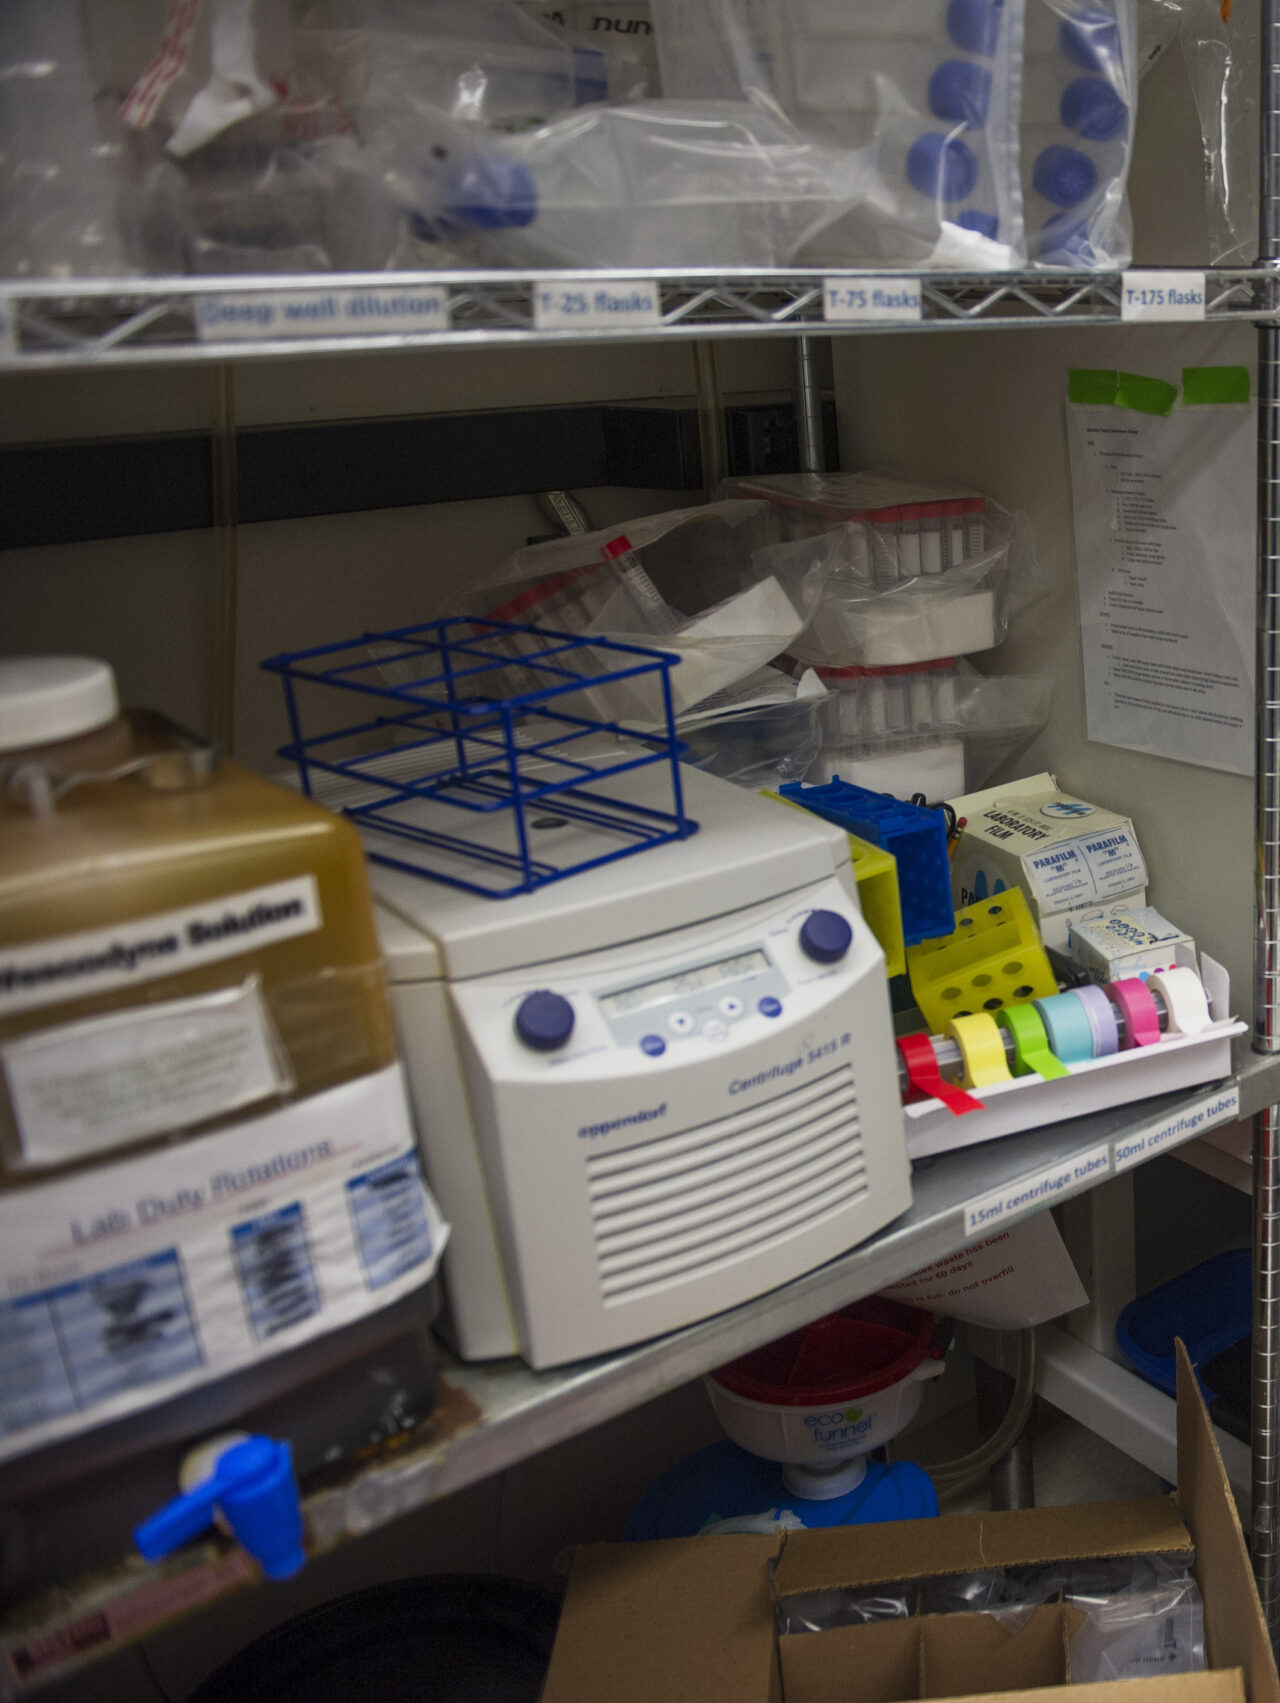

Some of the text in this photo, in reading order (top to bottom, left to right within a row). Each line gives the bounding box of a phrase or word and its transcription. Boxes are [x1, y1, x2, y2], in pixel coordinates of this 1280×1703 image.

[590, 16, 654, 34] nun
[593, 290, 654, 313] flasks
[828, 289, 920, 310] T-75 flasks
[1126, 287, 1203, 306] T-175 flasks
[983, 809, 1051, 841] LABORATORY
[985, 824, 1015, 841] FILM
[1086, 834, 1128, 854] PARAFILM
[1033, 850, 1078, 869] PARAFILM
[729, 1058, 803, 1095] Centrifuge
[578, 1103, 667, 1140] eppendorf
[1116, 1095, 1237, 1162] 50ml centrifuge tubes
[970, 1155, 1107, 1227] 15ml centrifuge tubes
[935, 1231, 1010, 1268] waste has been
[919, 1274, 935, 1285] for
[950, 1259, 974, 1275] days
[948, 1287, 961, 1297] do
[963, 1280, 979, 1292] not
[981, 1265, 1015, 1285] overfill
[803, 1412, 844, 1427] eco
[813, 1415, 872, 1442] funnel
